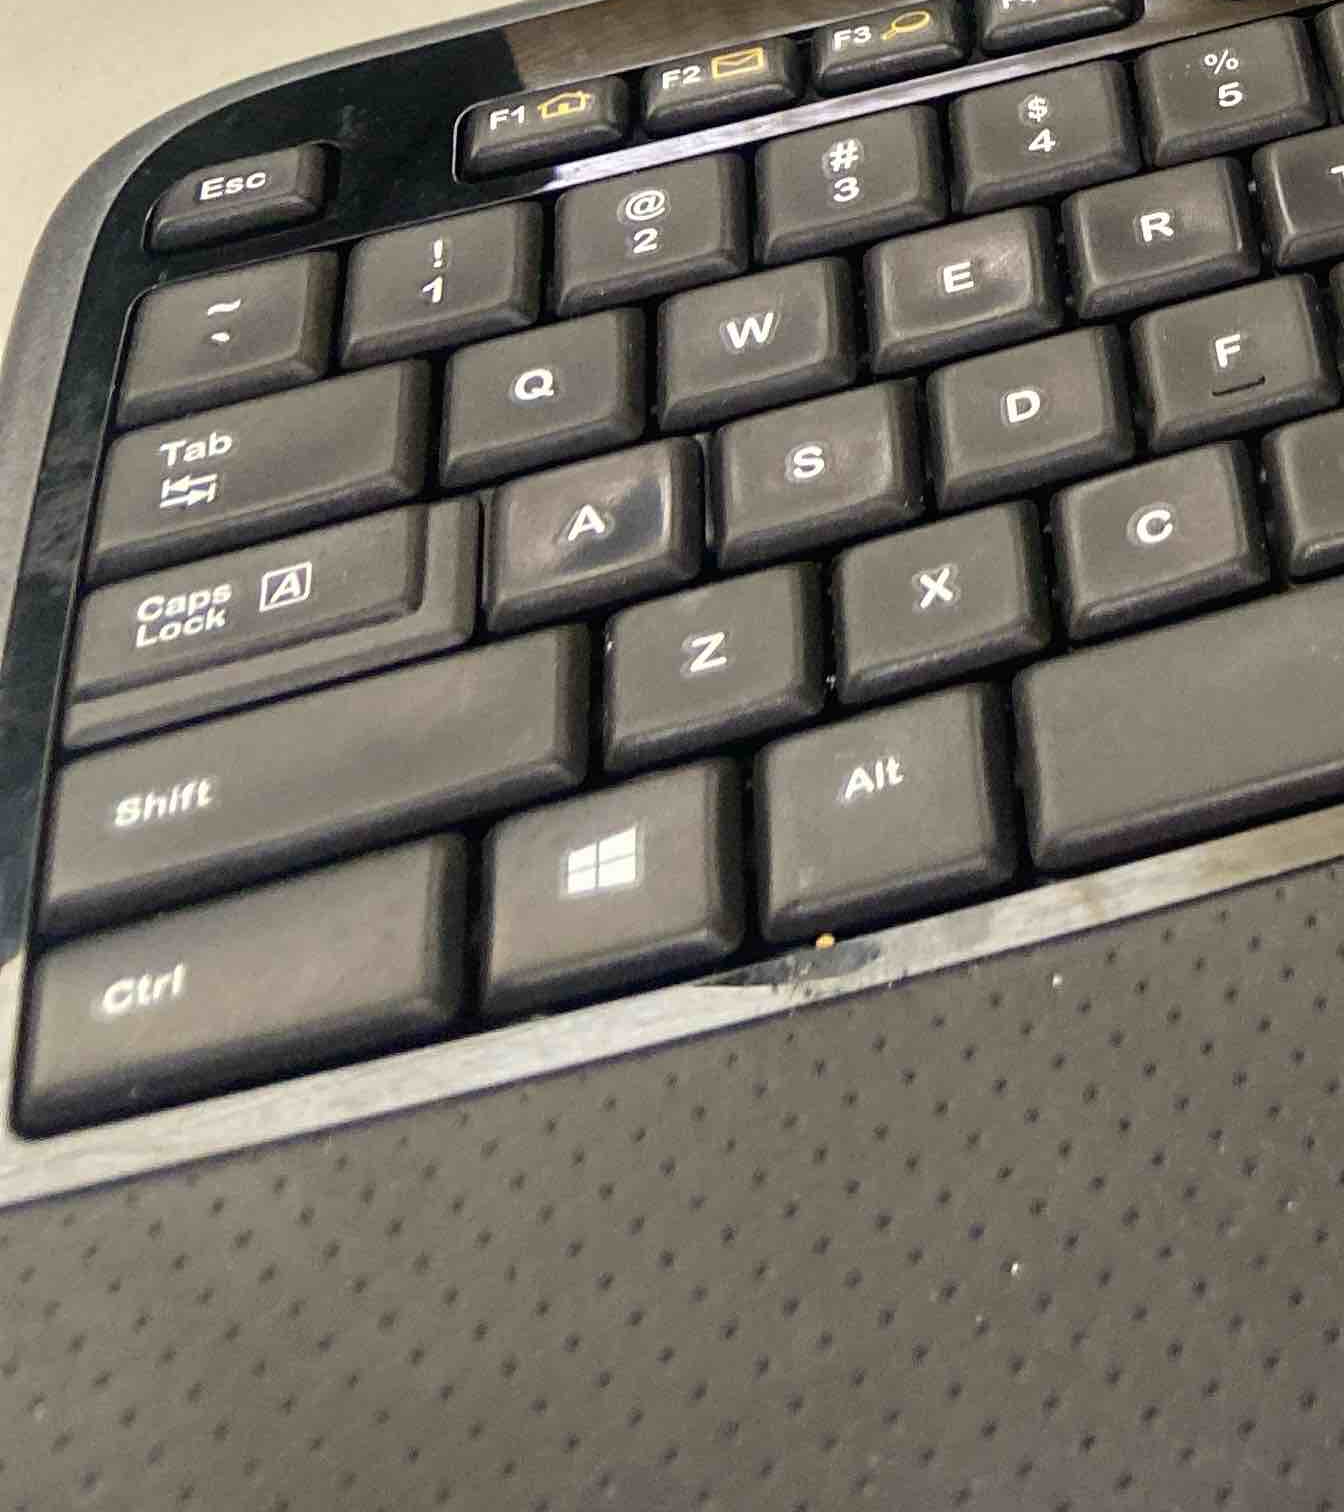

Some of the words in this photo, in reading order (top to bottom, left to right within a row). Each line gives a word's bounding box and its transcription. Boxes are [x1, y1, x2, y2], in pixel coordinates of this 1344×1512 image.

[832, 25, 872, 52] F3
[662, 65, 705, 91] F2
[1218, 81, 1243, 108] 5
[489, 105, 525, 131] F1
[1028, 128, 1056, 153] 4
[199, 172, 267, 200] Esc
[833, 176, 860, 203] 3
[633, 227, 658, 254] 2
[1139, 211, 1175, 243] R
[422, 276, 443, 303] 1
[942, 259, 974, 294] E
[726, 311, 774, 349] W
[1214, 333, 1241, 369] F
[514, 368, 555, 401] Q
[1006, 389, 1041, 423] D
[159, 431, 233, 467] Tab
[792, 445, 825, 479] S
[567, 504, 606, 542] A
[1136, 509, 1174, 544] C
[135, 580, 233, 623] Caps
[919, 567, 954, 609] X
[135, 608, 227, 648] Lock
[689, 631, 727, 673] Z
[844, 755, 904, 801] Alt
[114, 778, 212, 828] Shift
[101, 963, 188, 1016] Ctrl
